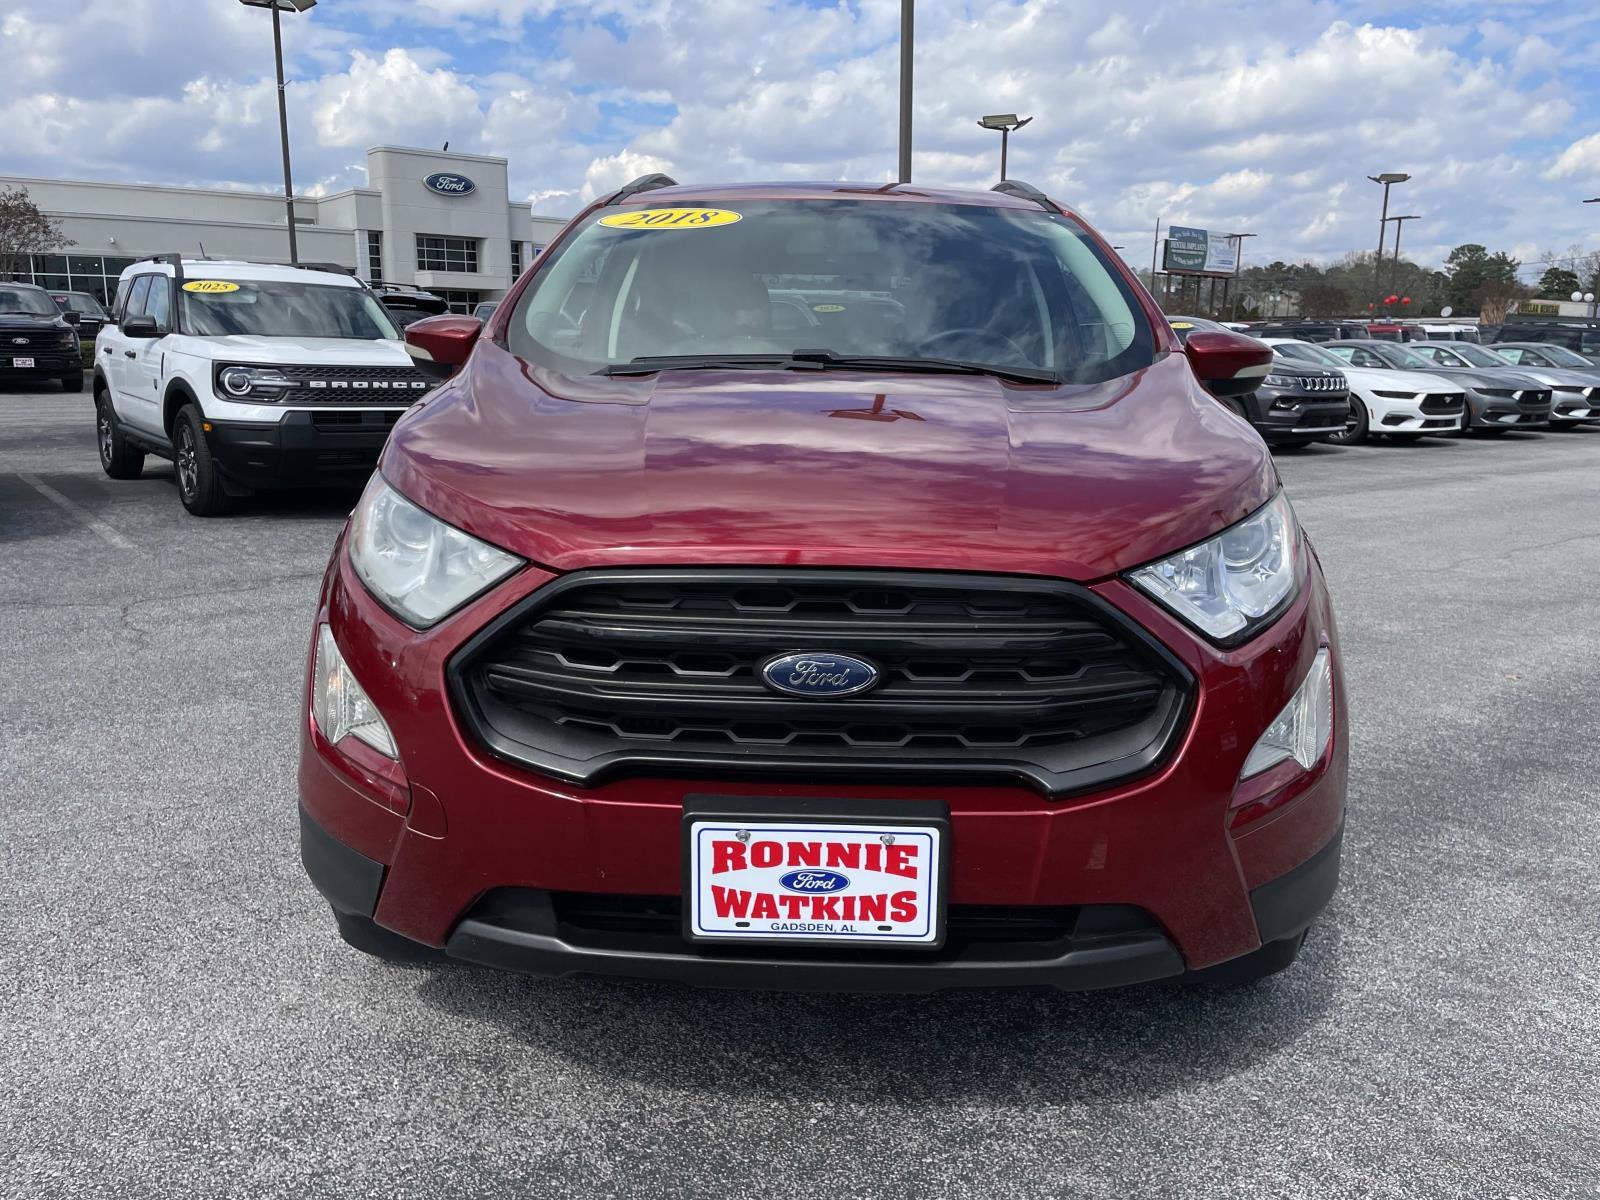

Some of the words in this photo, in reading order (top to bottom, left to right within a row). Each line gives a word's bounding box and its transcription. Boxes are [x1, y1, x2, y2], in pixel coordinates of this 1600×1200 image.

[436, 176, 465, 191] Ford
[618, 211, 719, 225] 2018
[309, 380, 424, 388] BRONCO
[789, 660, 850, 687] Ford
[712, 840, 918, 880] RONNIE
[793, 872, 836, 890] Ford
[711, 884, 918, 923] WATKINS
[770, 922, 837, 934] GADSDEN,
[840, 924, 857, 933] AL
